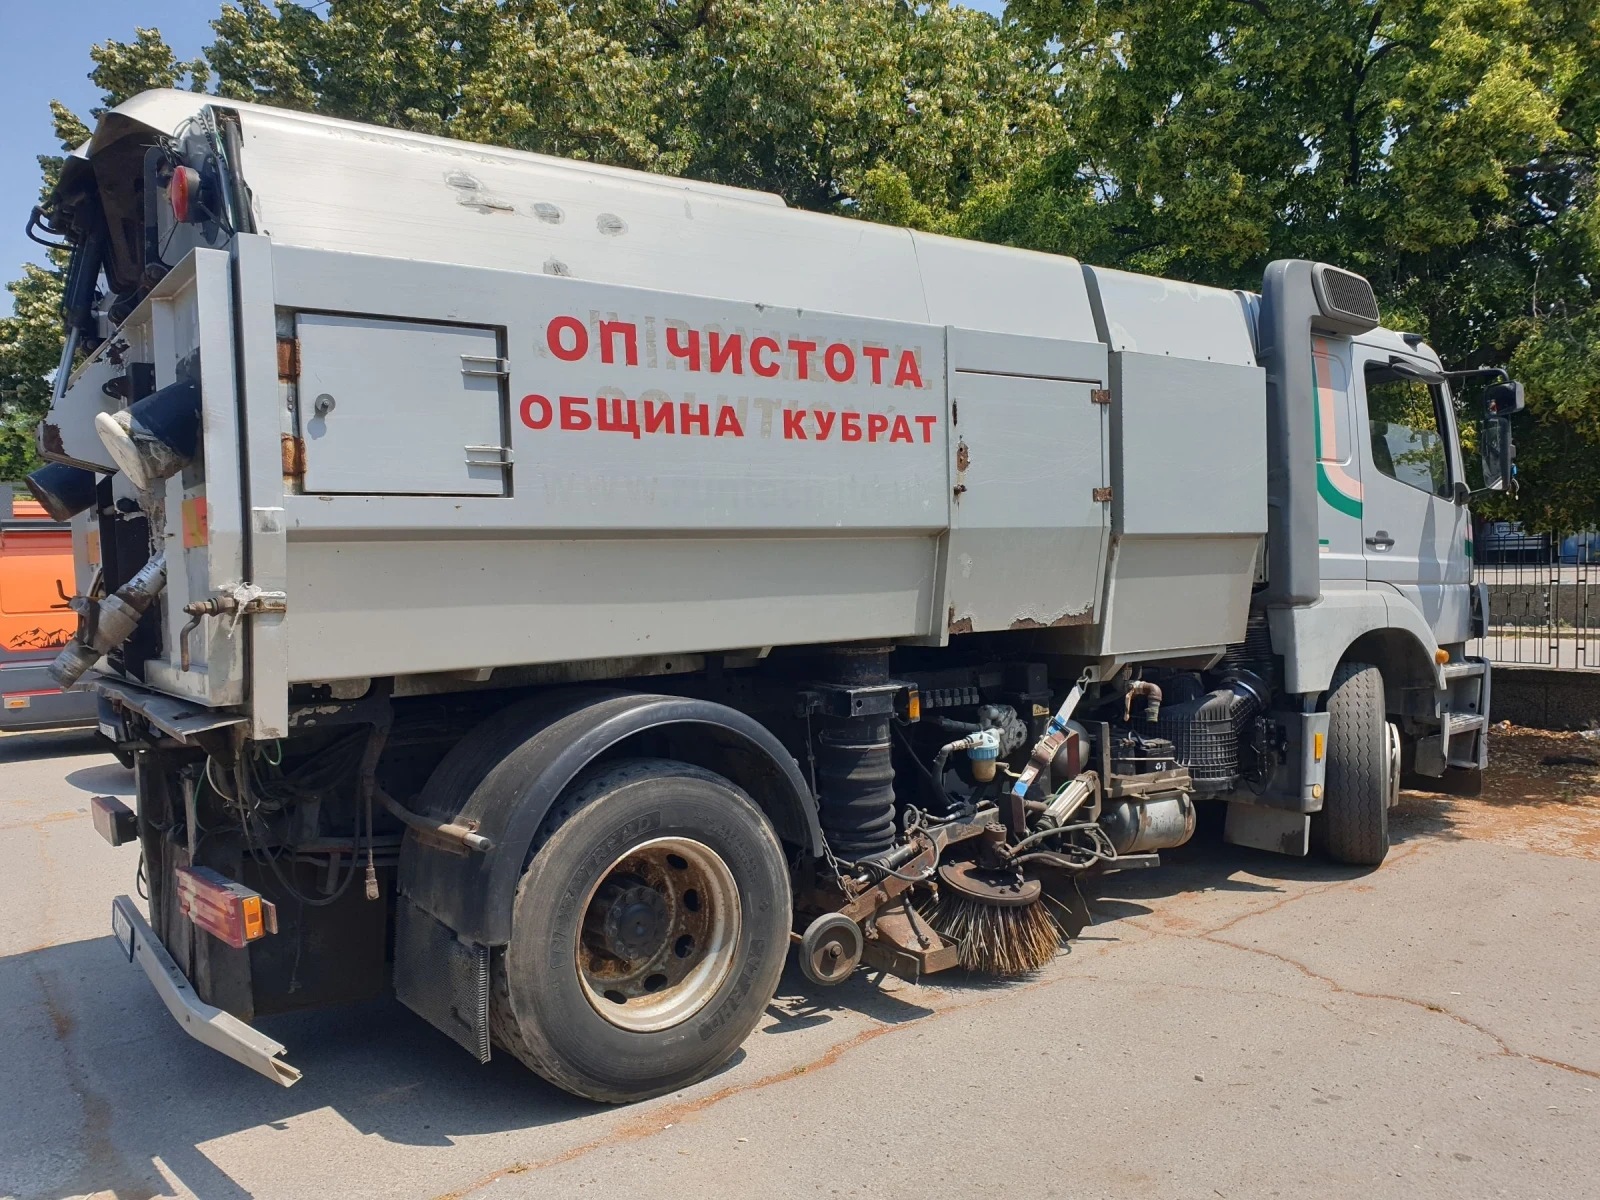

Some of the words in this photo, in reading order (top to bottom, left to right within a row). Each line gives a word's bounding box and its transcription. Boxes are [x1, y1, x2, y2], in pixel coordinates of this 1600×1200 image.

[547, 316, 638, 365] ОП
[666, 328, 923, 388] ЧИСТОТА
[519, 394, 744, 440] ОБЩИНА
[783, 409, 937, 443] КУБРАТ
